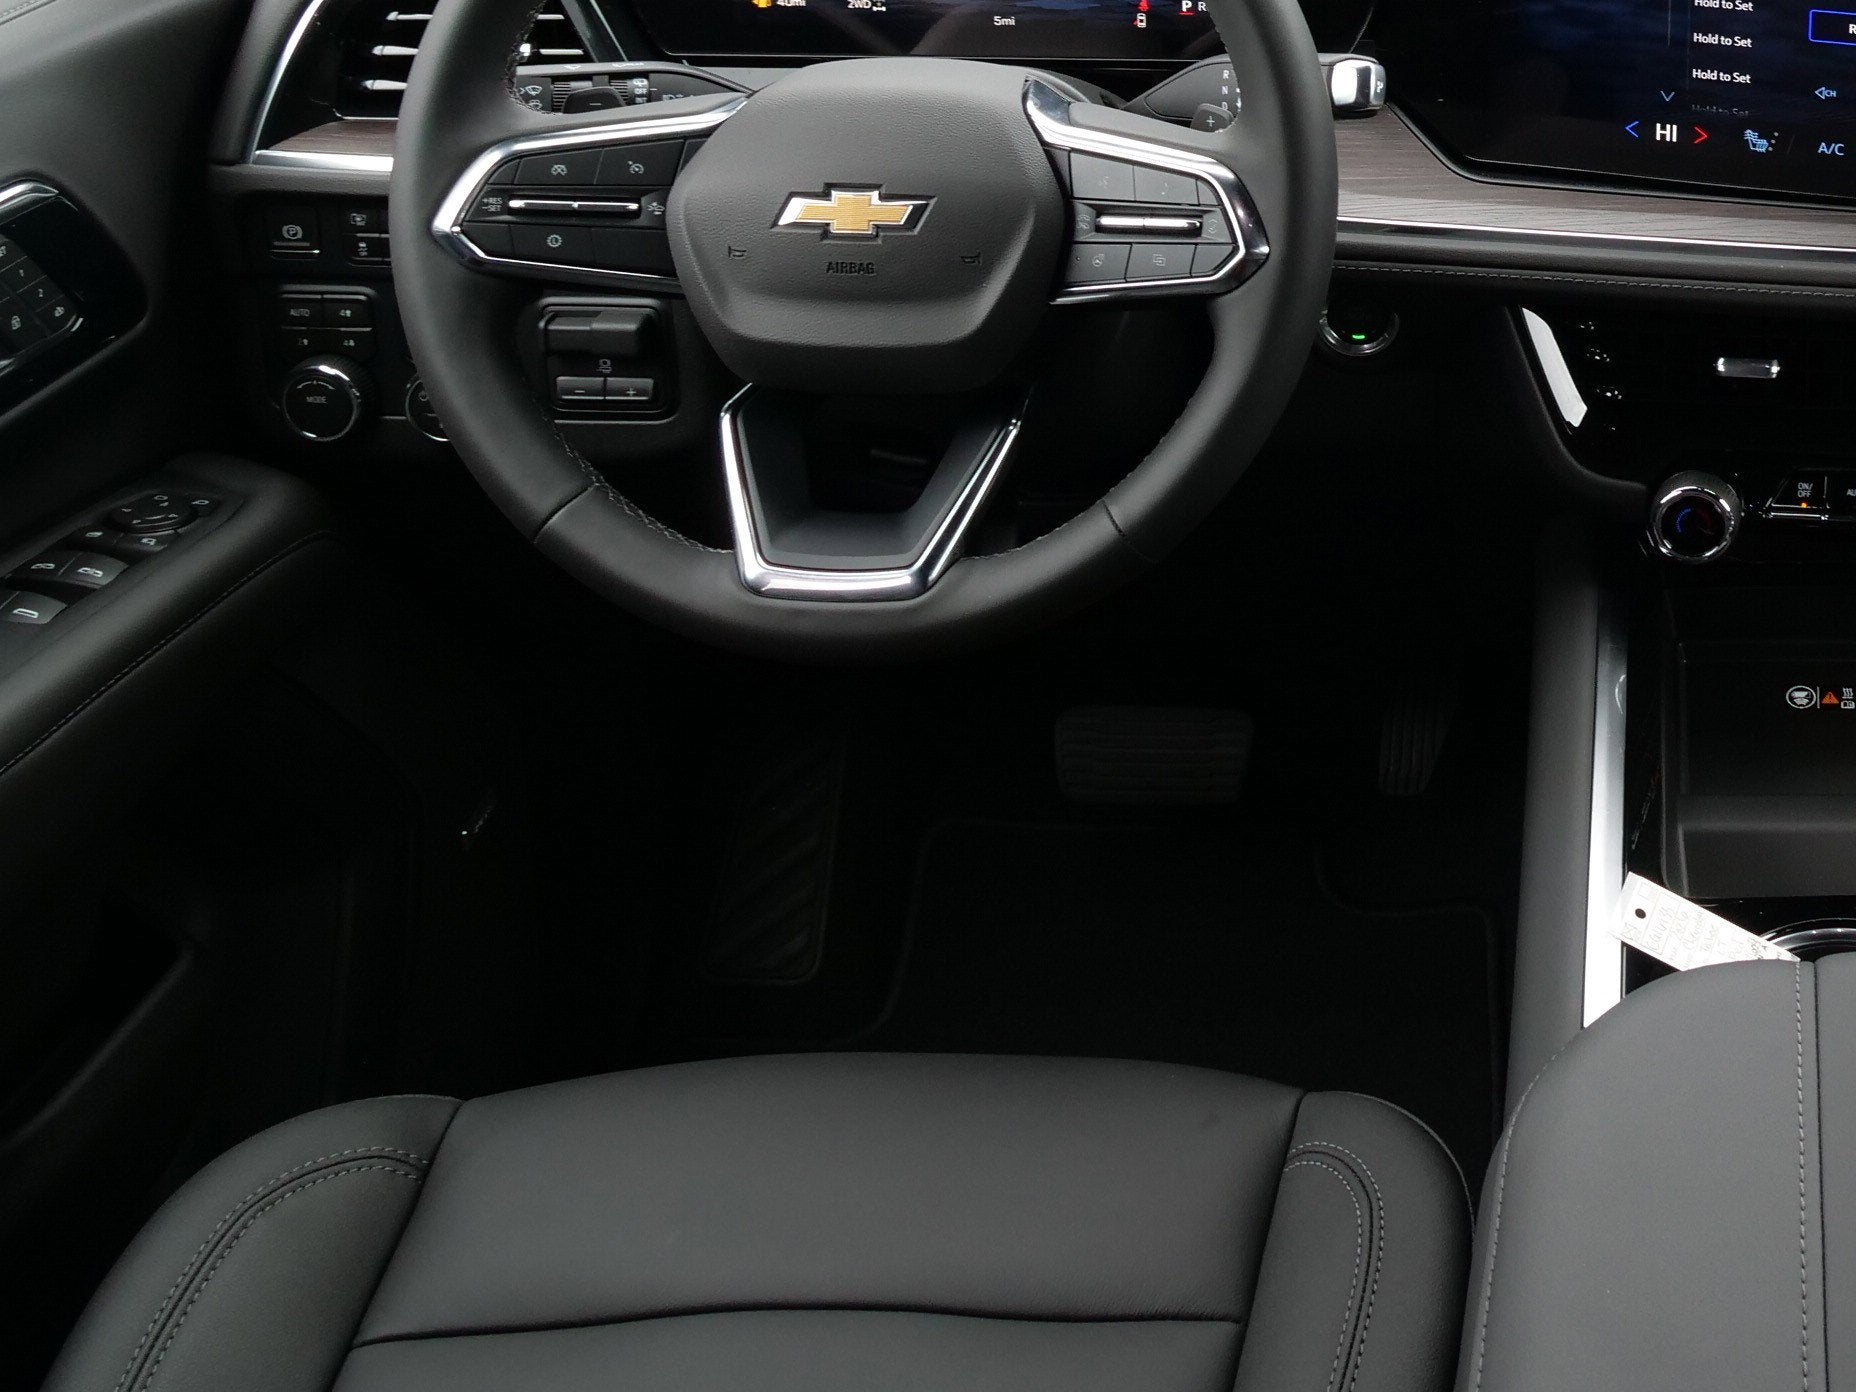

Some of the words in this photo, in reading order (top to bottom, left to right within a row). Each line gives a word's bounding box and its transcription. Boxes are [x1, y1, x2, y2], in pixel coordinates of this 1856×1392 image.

[847, 0, 872, 10] 2WD
[1181, 0, 1192, 12] P
[1197, 1, 1207, 12] R
[1720, 0, 1733, 11] to
[1734, 0, 1754, 12] Set
[993, 15, 1016, 26] 5mi
[1693, 32, 1718, 46] Hold
[1719, 35, 1731, 47] to
[1732, 36, 1752, 49] Set
[1222, 70, 1229, 80] R
[1692, 68, 1718, 81] Hold
[1719, 71, 1731, 82] to
[1732, 72, 1751, 84] Set
[1221, 85, 1229, 95] N
[1824, 89, 1837, 98] CH
[1655, 123, 1678, 143] HI
[1818, 142, 1845, 156] A/C
[825, 259, 876, 276] AIRBAG
[1797, 490, 1812, 499] OFF
